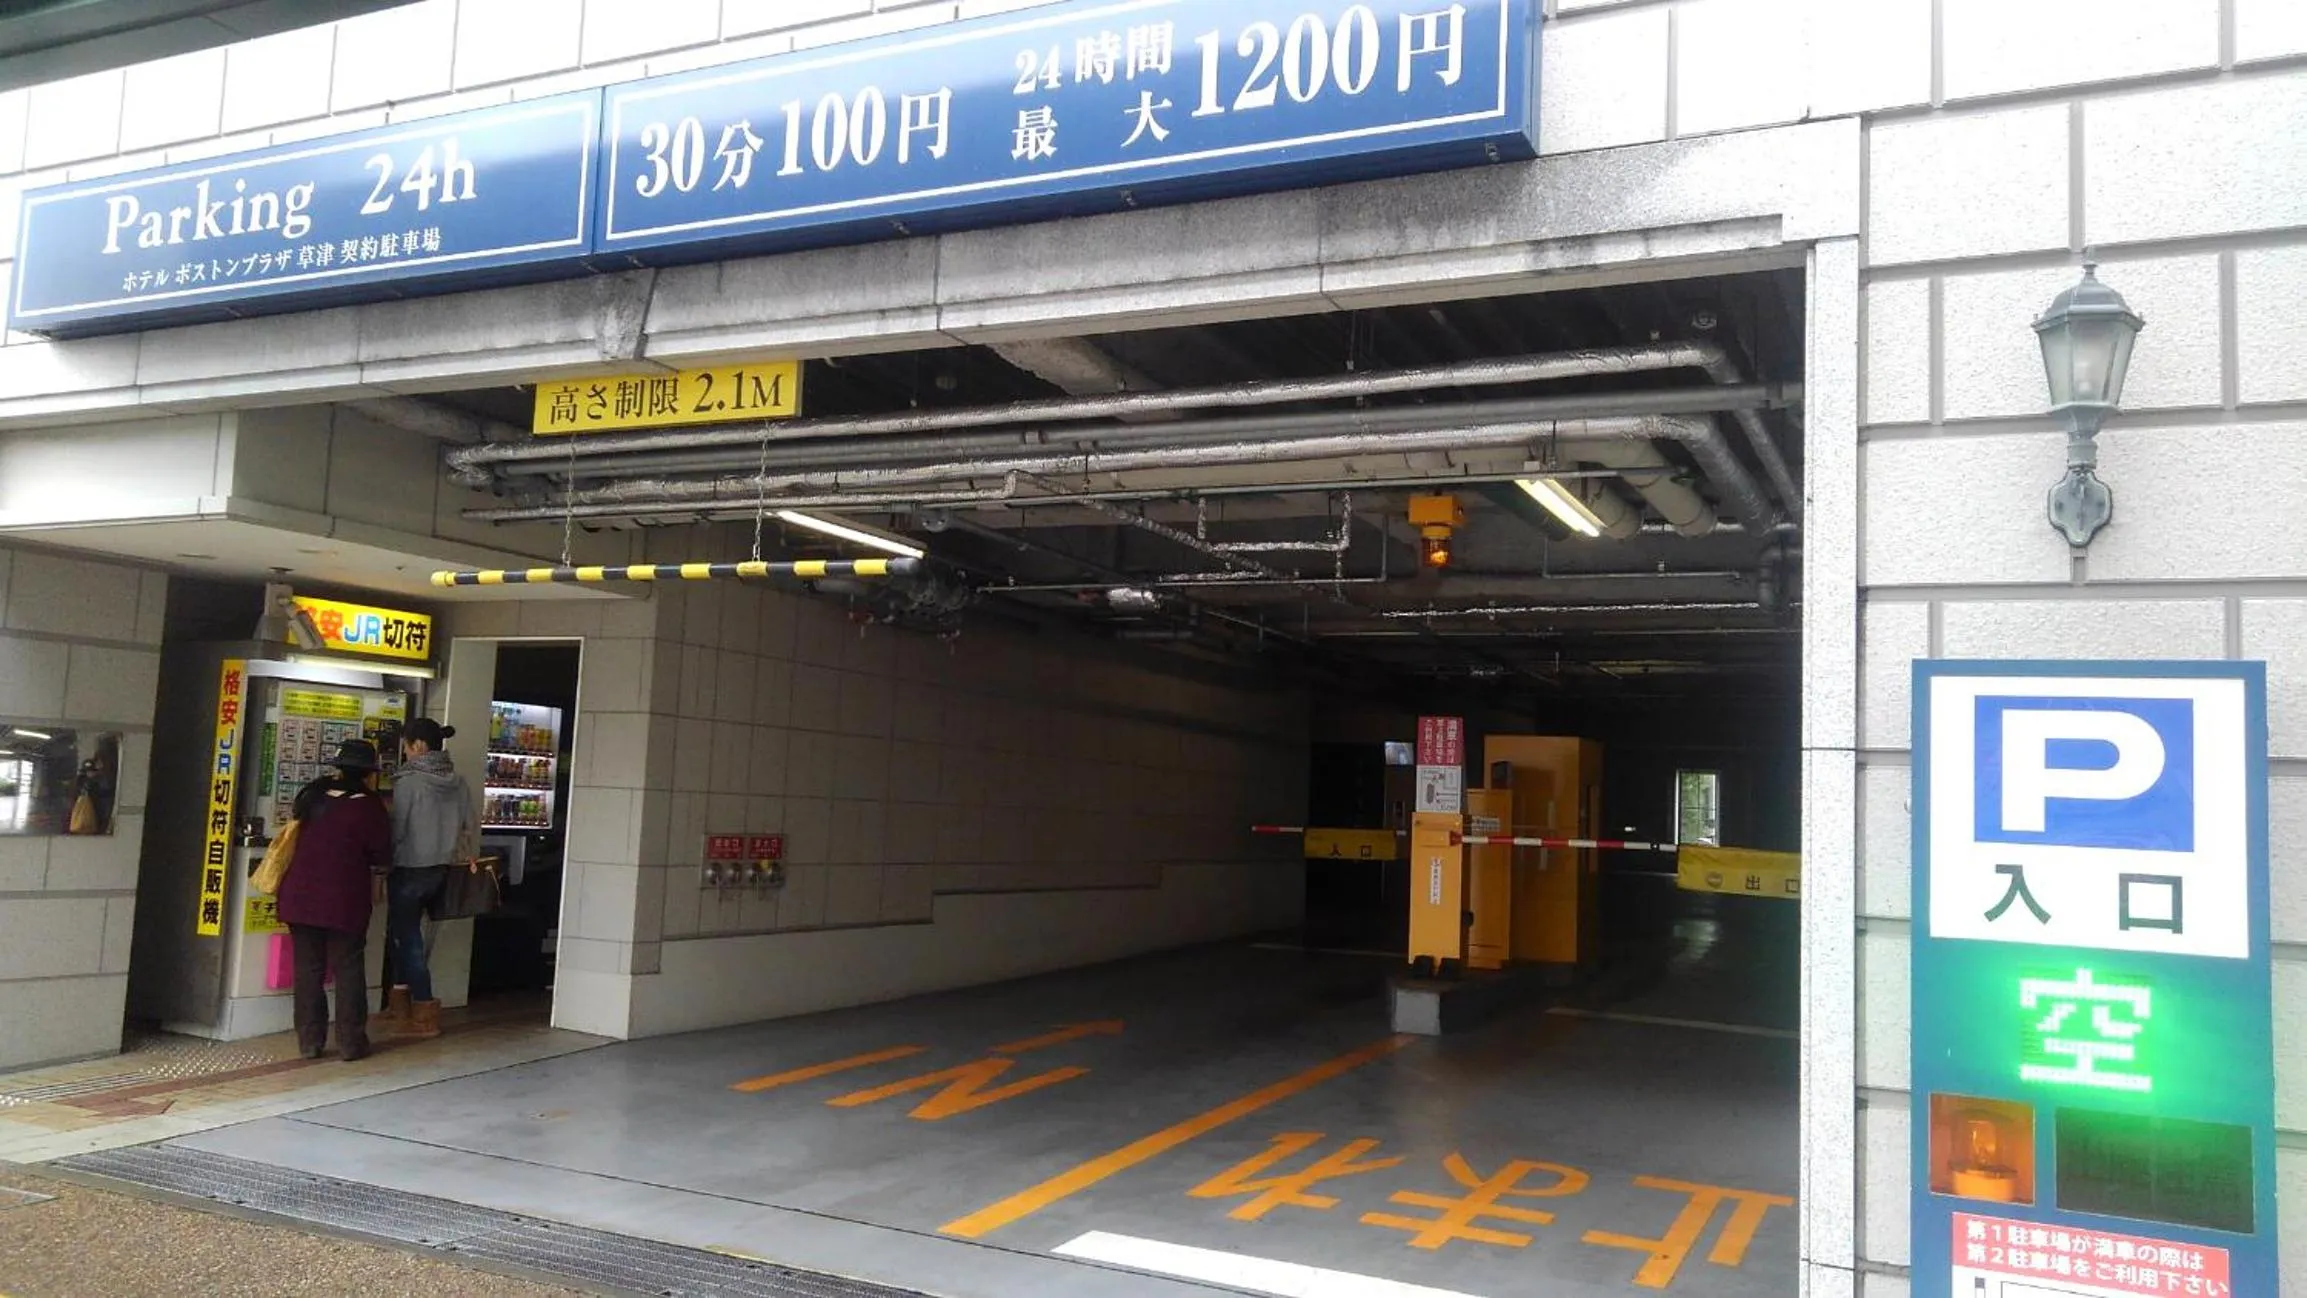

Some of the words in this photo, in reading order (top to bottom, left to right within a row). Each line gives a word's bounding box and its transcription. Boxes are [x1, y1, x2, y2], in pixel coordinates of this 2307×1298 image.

[1014, 20, 1174, 95] 24時間
[1191, 2, 1466, 119] 1200円
[1011, 89, 1170, 162] 最大
[103, 178, 315, 254] Parking
[360, 137, 478, 216] 24h
[121, 267, 170, 294] ホテル
[296, 242, 337, 270] 草津
[340, 227, 442, 264] 契約駐車場
[550, 380, 679, 427] 高さ制限
[693, 371, 783, 413] 2.1M
[201, 668, 242, 926] 格安JR切符自販機
[2001, 709, 2165, 833] P
[1745, 874, 1800, 893] 出口
[1983, 863, 2184, 935] 入口
[2019, 969, 2152, 1092] 空
